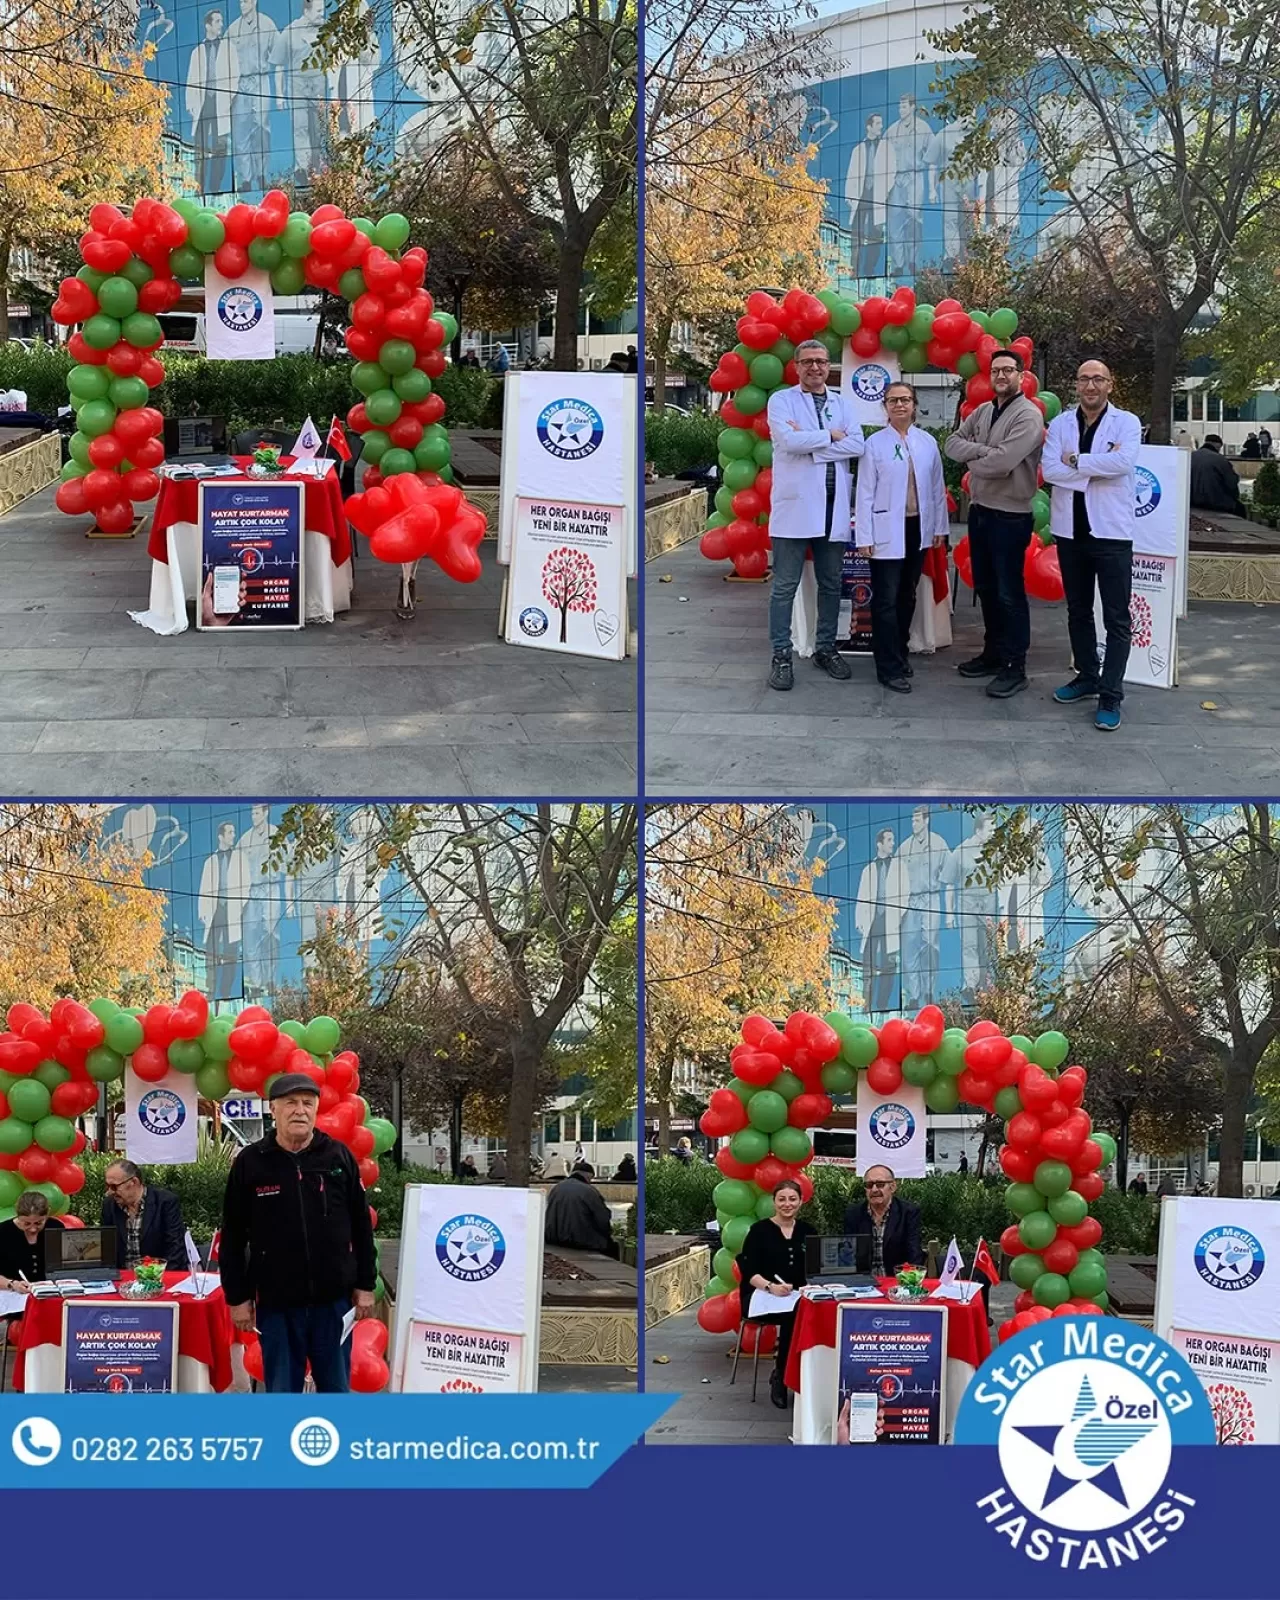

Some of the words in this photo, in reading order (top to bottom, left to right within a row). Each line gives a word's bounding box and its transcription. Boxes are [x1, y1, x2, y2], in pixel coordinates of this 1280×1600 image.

[541, 404, 560, 422] Star
[563, 401, 598, 424] Medica
[211, 510, 238, 518] HAYAT
[239, 509, 290, 517] KURTARMAK
[240, 519, 257, 527] ÇOK
[259, 518, 286, 526] KOLAY
[530, 505, 547, 516] HER
[549, 507, 580, 520] ORGAN
[582, 508, 611, 525] BAĞIŞI
[532, 518, 552, 531] YENİ
[553, 519, 566, 532] BİR
[568, 523, 608, 536] HAYATTIR
[441, 1220, 460, 1239] Star
[464, 1216, 500, 1243] Medica
[1199, 1232, 1218, 1250] Star
[1222, 1228, 1260, 1254] Medica
[76, 1332, 104, 1340] HAYAT
[107, 1332, 161, 1340] KURTARMAK
[107, 1342, 127, 1350] ÇOK
[425, 1331, 441, 1343] HER
[443, 1333, 476, 1348] ORGAN
[478, 1337, 510, 1355] BAĞIŞI
[879, 1334, 931, 1342] KURTARMAK
[426, 1346, 446, 1360] YENİ
[448, 1347, 462, 1362] BİR
[464, 1351, 505, 1368] HAYATTIR
[880, 1343, 899, 1352] ÇOK
[1186, 1338, 1203, 1350] HER
[1204, 1340, 1238, 1354] ORGAN
[1240, 1343, 1271, 1361] BAĞIŞI
[1188, 1352, 1208, 1365] YENİ
[1209, 1354, 1223, 1367] BİR
[1225, 1357, 1267, 1373] HAYATTIR
